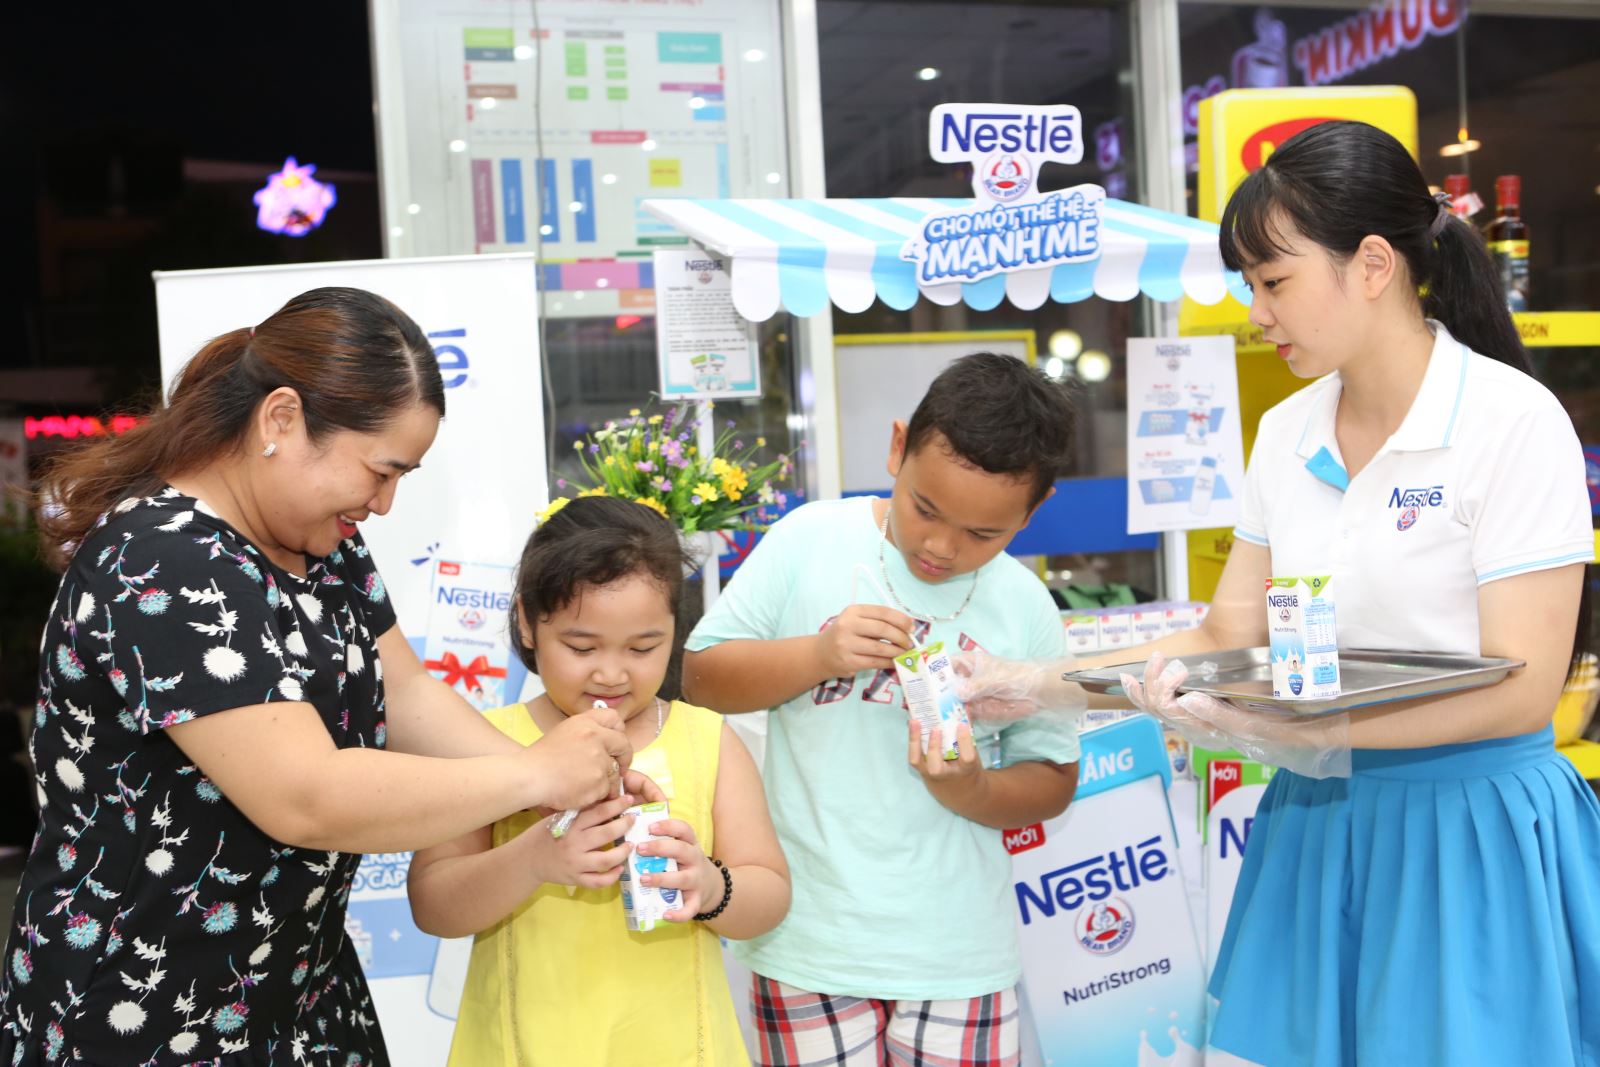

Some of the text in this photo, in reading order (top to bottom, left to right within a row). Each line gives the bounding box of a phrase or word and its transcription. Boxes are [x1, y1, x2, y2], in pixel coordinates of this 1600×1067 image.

[941, 113, 1074, 153] Nestlé
[926, 192, 1085, 240] CHO MỘT THẾ HỆ
[926, 210, 1099, 278] MẠNH MẼ
[1519, 323, 1549, 338] GON
[437, 586, 510, 611] Nestlé
[1268, 595, 1298, 608] Nestlé
[1005, 826, 1038, 850] MỚI
[1014, 835, 1168, 926] Nestlé
[1063, 957, 1171, 1005] NutriStrong
